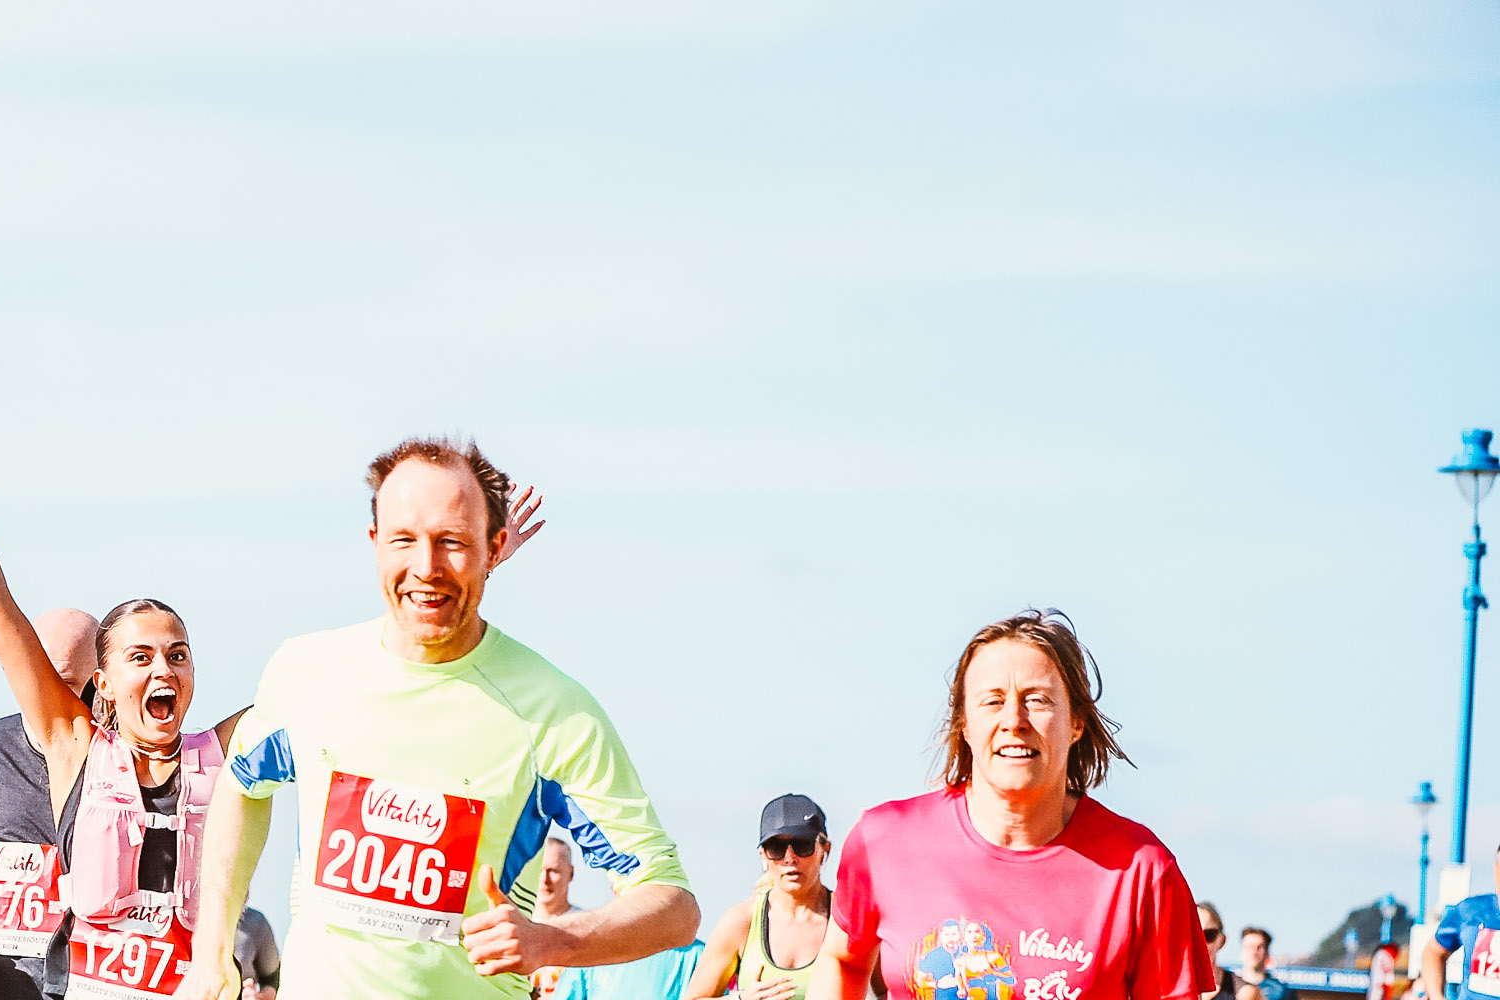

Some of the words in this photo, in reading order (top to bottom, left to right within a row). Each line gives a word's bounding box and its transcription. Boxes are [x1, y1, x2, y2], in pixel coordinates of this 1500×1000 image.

[367, 788, 442, 838] Vitality
[321, 828, 447, 906] 2046
[358, 916, 379, 926] BAY
[380, 920, 404, 932] RUN
[366, 906, 450, 928] BOURNEMOUTH
[83, 929, 175, 989] 1297
[1019, 928, 1094, 972] Vitality
[76, 982, 109, 996] VITALITY
